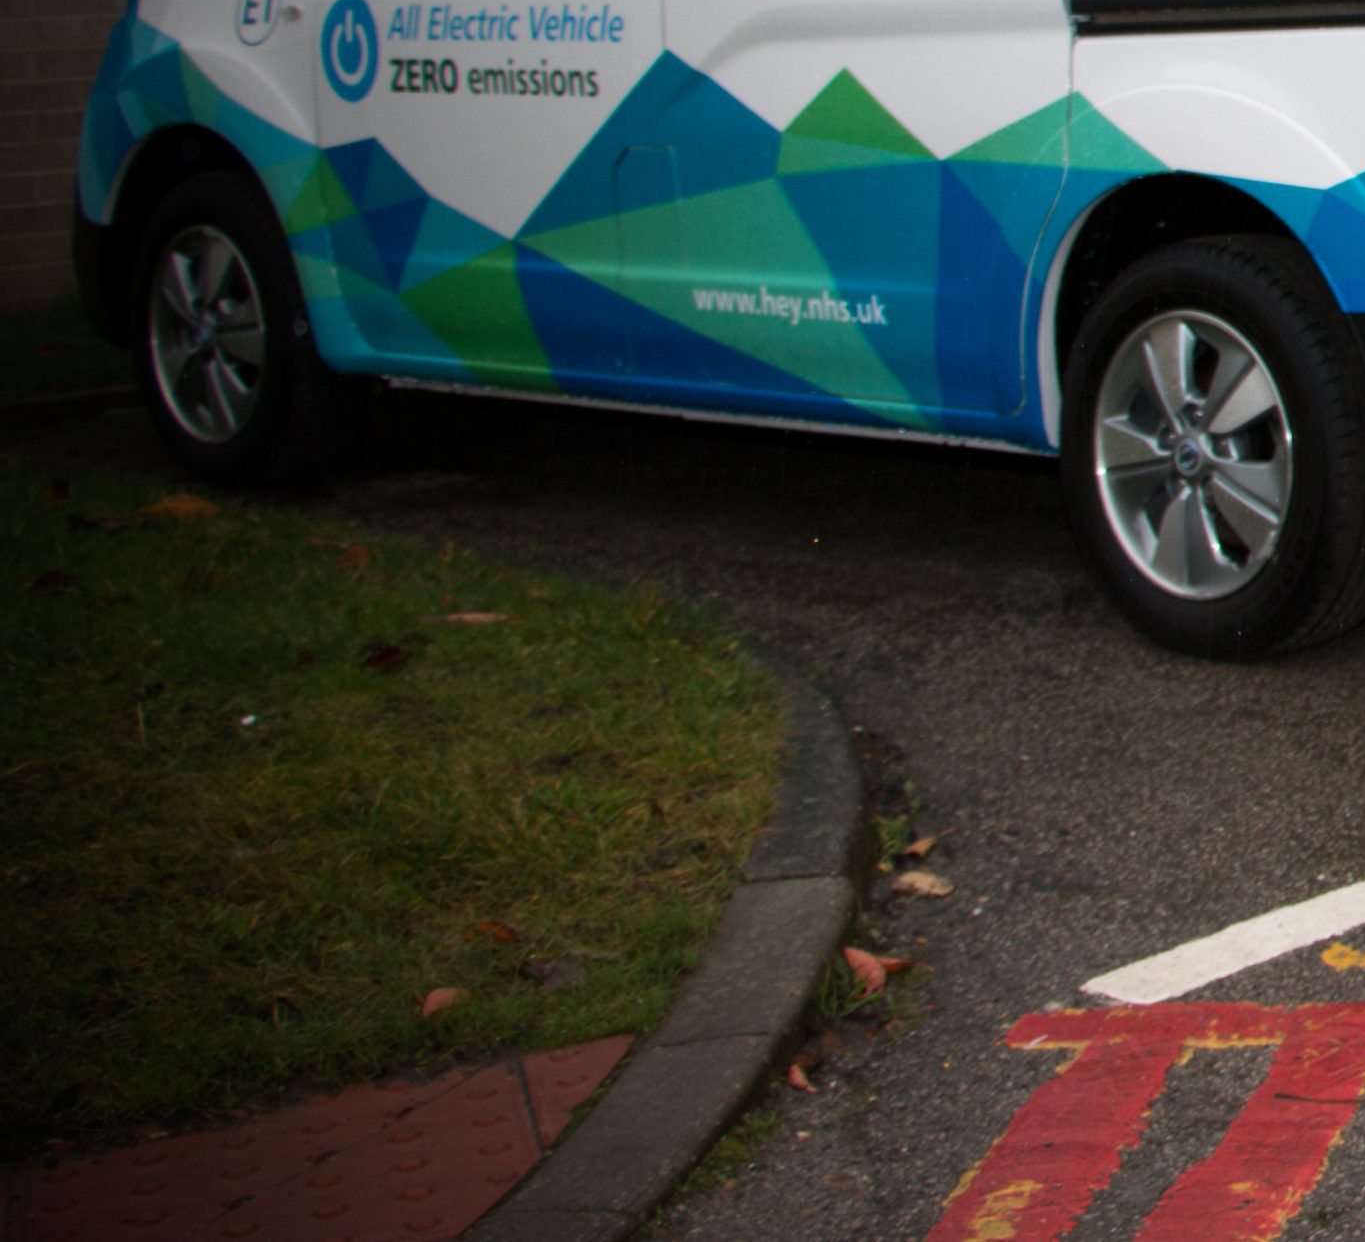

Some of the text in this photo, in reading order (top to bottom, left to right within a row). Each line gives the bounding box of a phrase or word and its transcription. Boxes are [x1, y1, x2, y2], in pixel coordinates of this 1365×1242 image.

[387, 4, 624, 43] All Electric Vehicle
[389, 58, 599, 98] ZERO emissions
[692, 285, 888, 326] www.hey.nhs.uk
